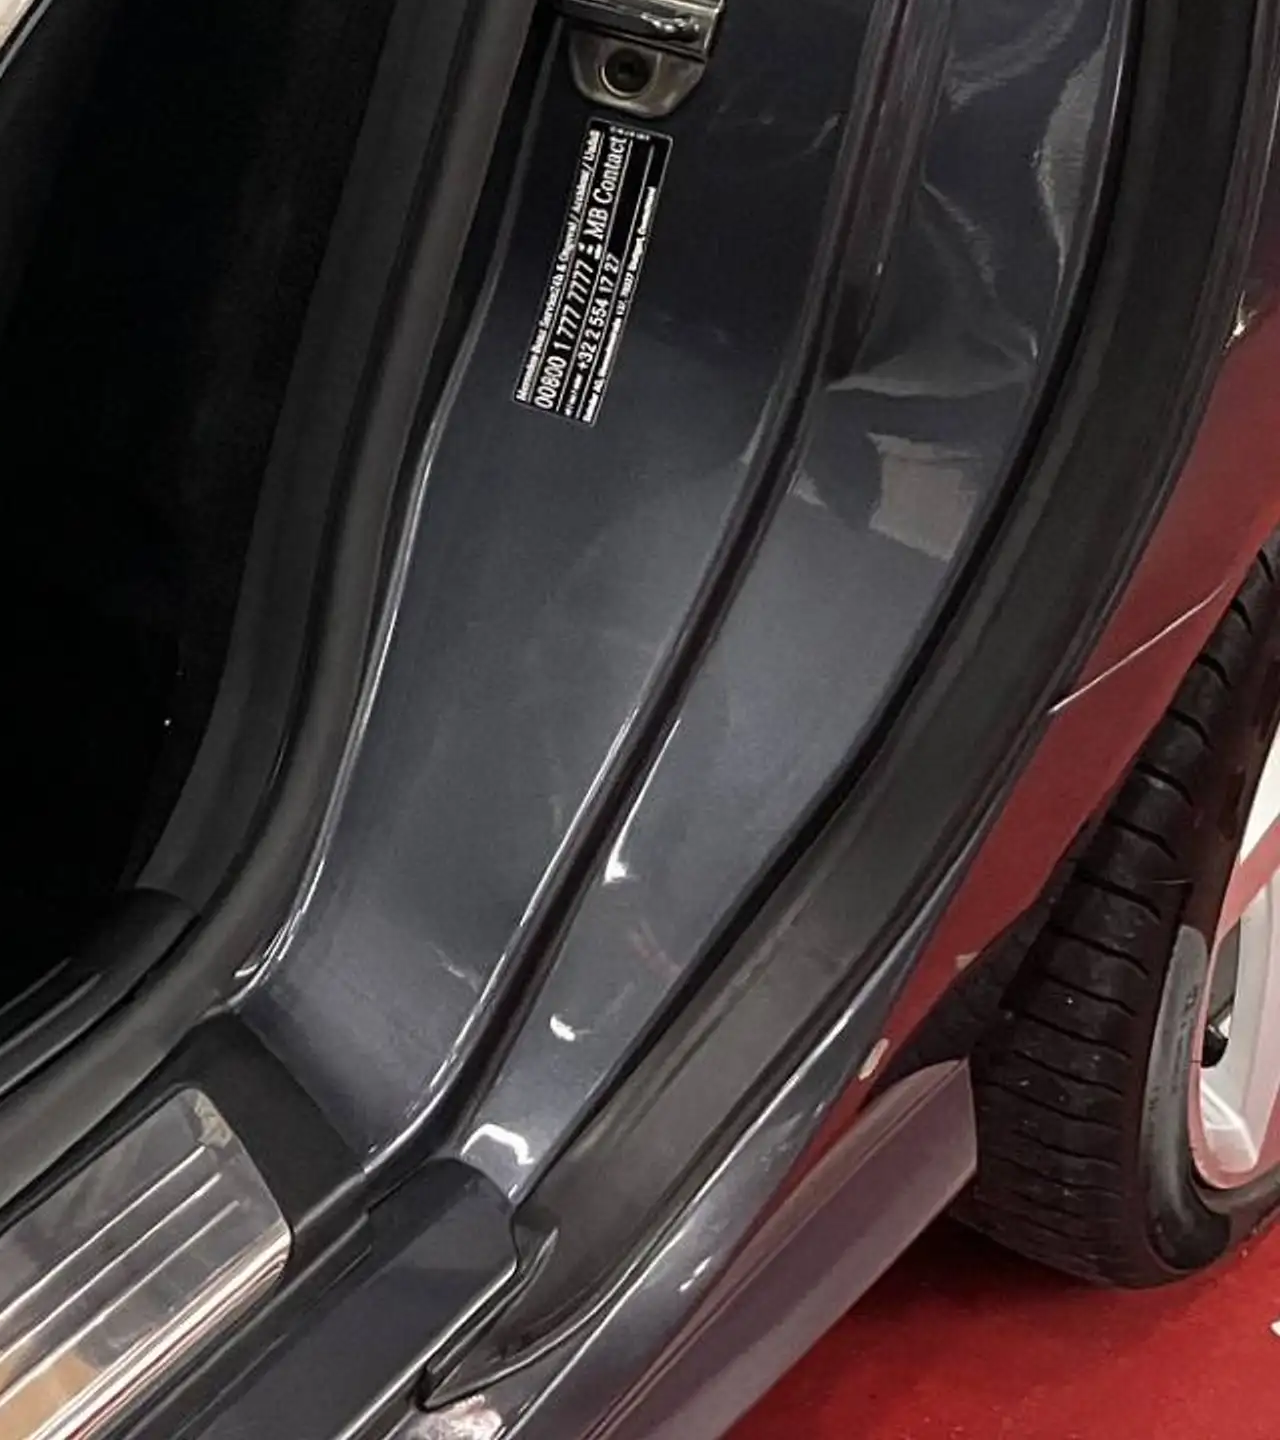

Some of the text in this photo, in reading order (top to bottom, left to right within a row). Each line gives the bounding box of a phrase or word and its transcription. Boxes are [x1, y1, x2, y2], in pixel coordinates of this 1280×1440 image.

[534, 136, 627, 409] 00800 1 777 7777 MB Contact
[577, 251, 620, 371] +32 2 554 17 27
